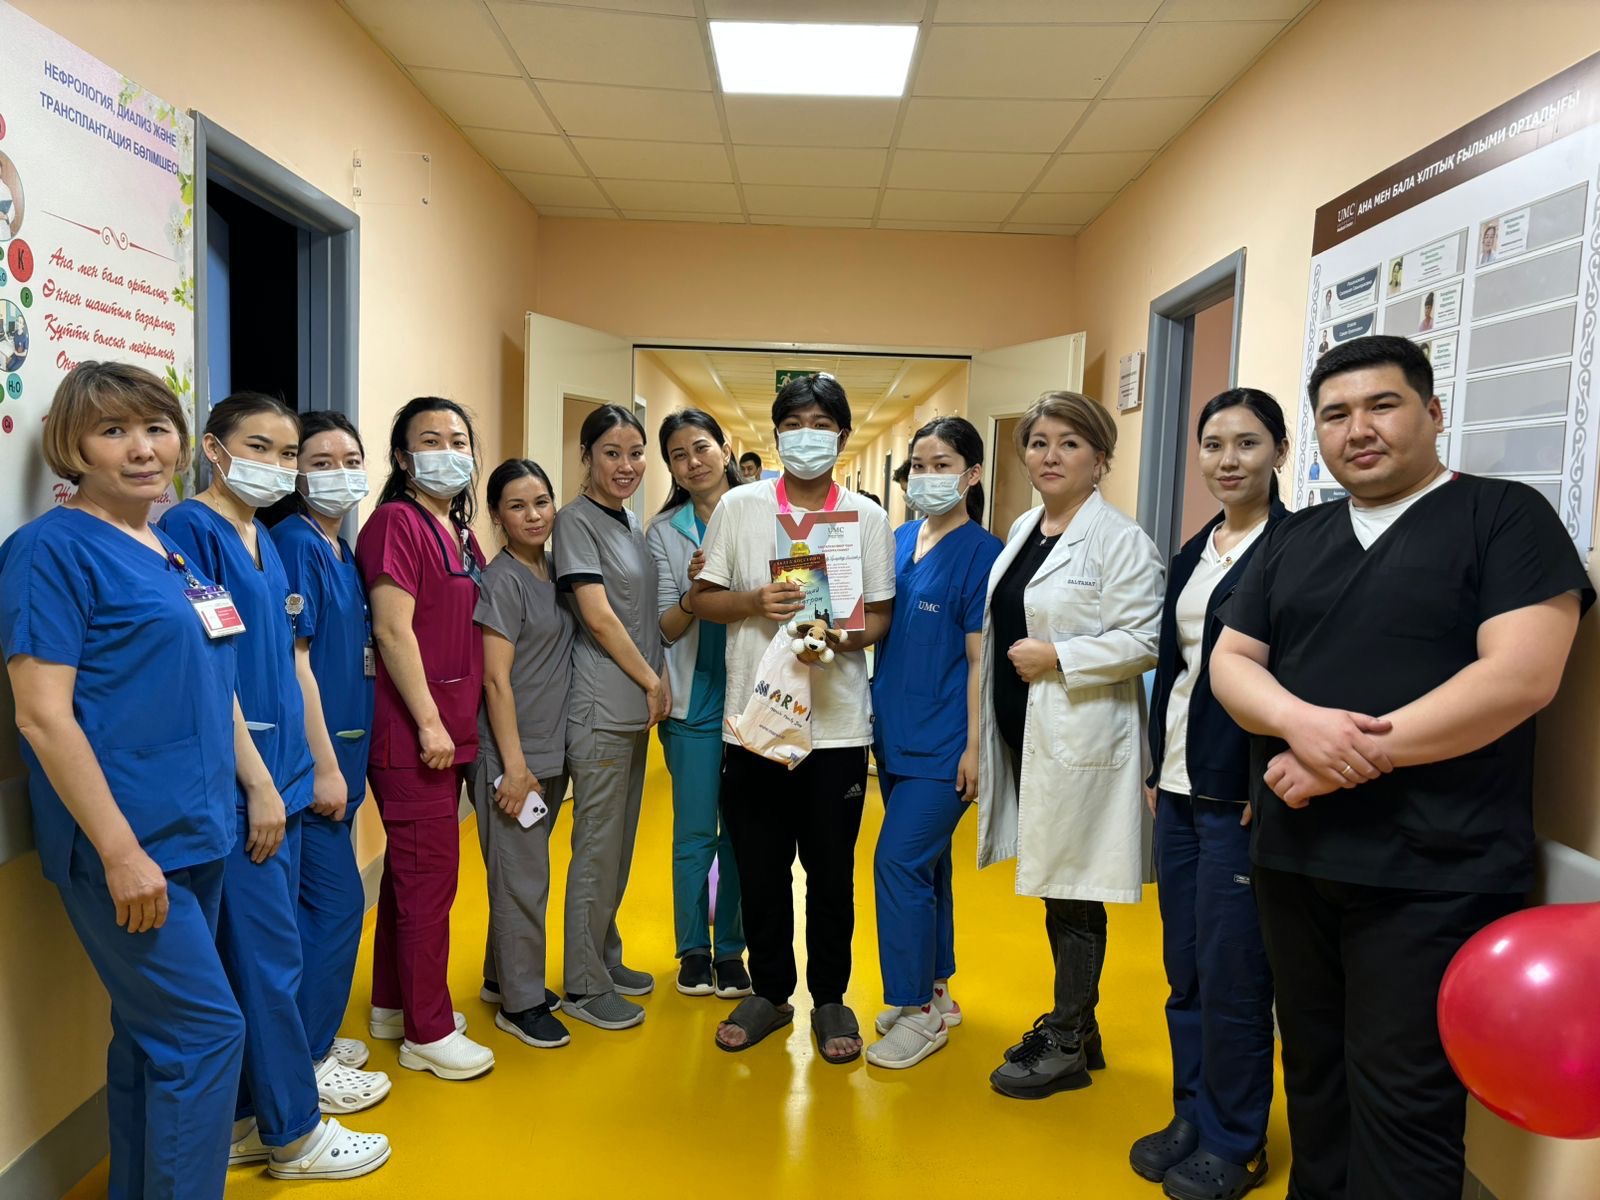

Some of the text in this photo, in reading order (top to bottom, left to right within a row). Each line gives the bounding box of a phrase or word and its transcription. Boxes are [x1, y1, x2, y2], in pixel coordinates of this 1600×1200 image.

[40, 91, 132, 152] ТРАНСПЛАНТАЦИЯ
[44, 60, 177, 148] НЕФРОЛОГИЯ, ДИАЛИЗ ЖӘНЕ
[1357, 90, 1580, 217] АНА МЕН БАЛА ҰЛТТЫҚ ҒЫЛЫМИ ОРТАЛЫҒЫ
[1337, 203, 1356, 222] UMC
[49, 247, 74, 271] Ана
[77, 263, 99, 278] мен
[102, 267, 124, 287] бала
[93, 329, 126, 349] болсын
[918, 600, 941, 613] UMC
